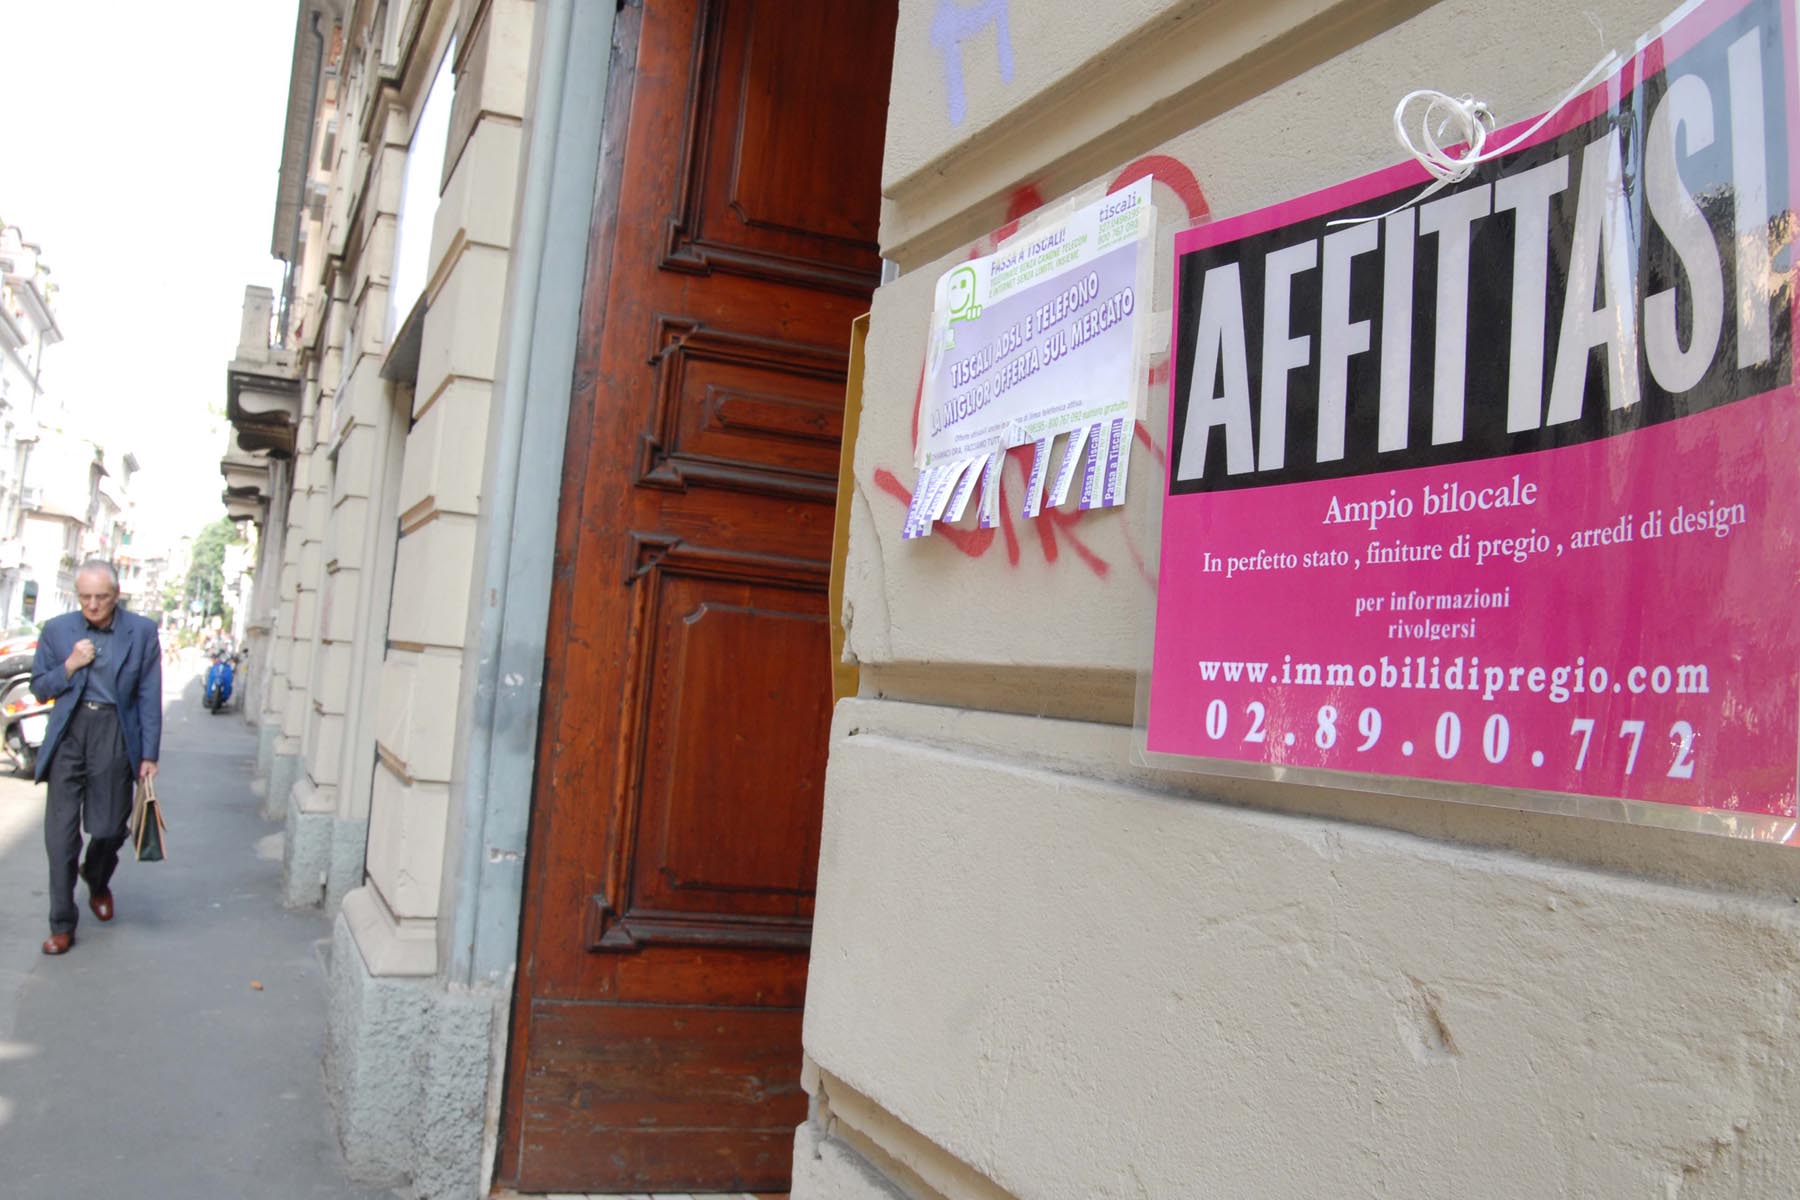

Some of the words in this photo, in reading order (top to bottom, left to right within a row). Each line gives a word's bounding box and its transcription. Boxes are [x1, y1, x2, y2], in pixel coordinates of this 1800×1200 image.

[1177, 25, 1771, 481] AFFITTASI
[951, 345, 993, 388] TISCALI
[995, 324, 1023, 363] ADSL
[1025, 315, 1033, 341] E
[1036, 271, 1099, 333] TELEFONO
[943, 381, 991, 428] MIGLIOR
[993, 347, 1040, 397] OFFERTA
[1043, 330, 1068, 366] SUL
[1071, 286, 1134, 349] MERCATO
[1081, 474, 1094, 503] Passa
[1088, 425, 1101, 465] Tiscali!
[1110, 422, 1123, 460] Tiscali!
[1023, 485, 1035, 512] Passa
[1104, 472, 1117, 500] Passa
[1322, 489, 1413, 530] Ampio
[1423, 474, 1537, 516] bilocale
[1202, 552, 1222, 572] In
[1226, 549, 1297, 578] perfetto
[1303, 549, 1349, 568] stato
[1366, 540, 1442, 564] finiture
[1449, 534, 1471, 558] di
[1476, 529, 1550, 565] pregio
[1570, 514, 1633, 549] arredi
[1640, 510, 1663, 540] di
[1669, 500, 1746, 538] design
[1355, 595, 1384, 616] per
[1390, 587, 1510, 611] informazioni
[1388, 617, 1475, 641] rivolgersi
[1199, 655, 1710, 703] www.immobilidipregio.com
